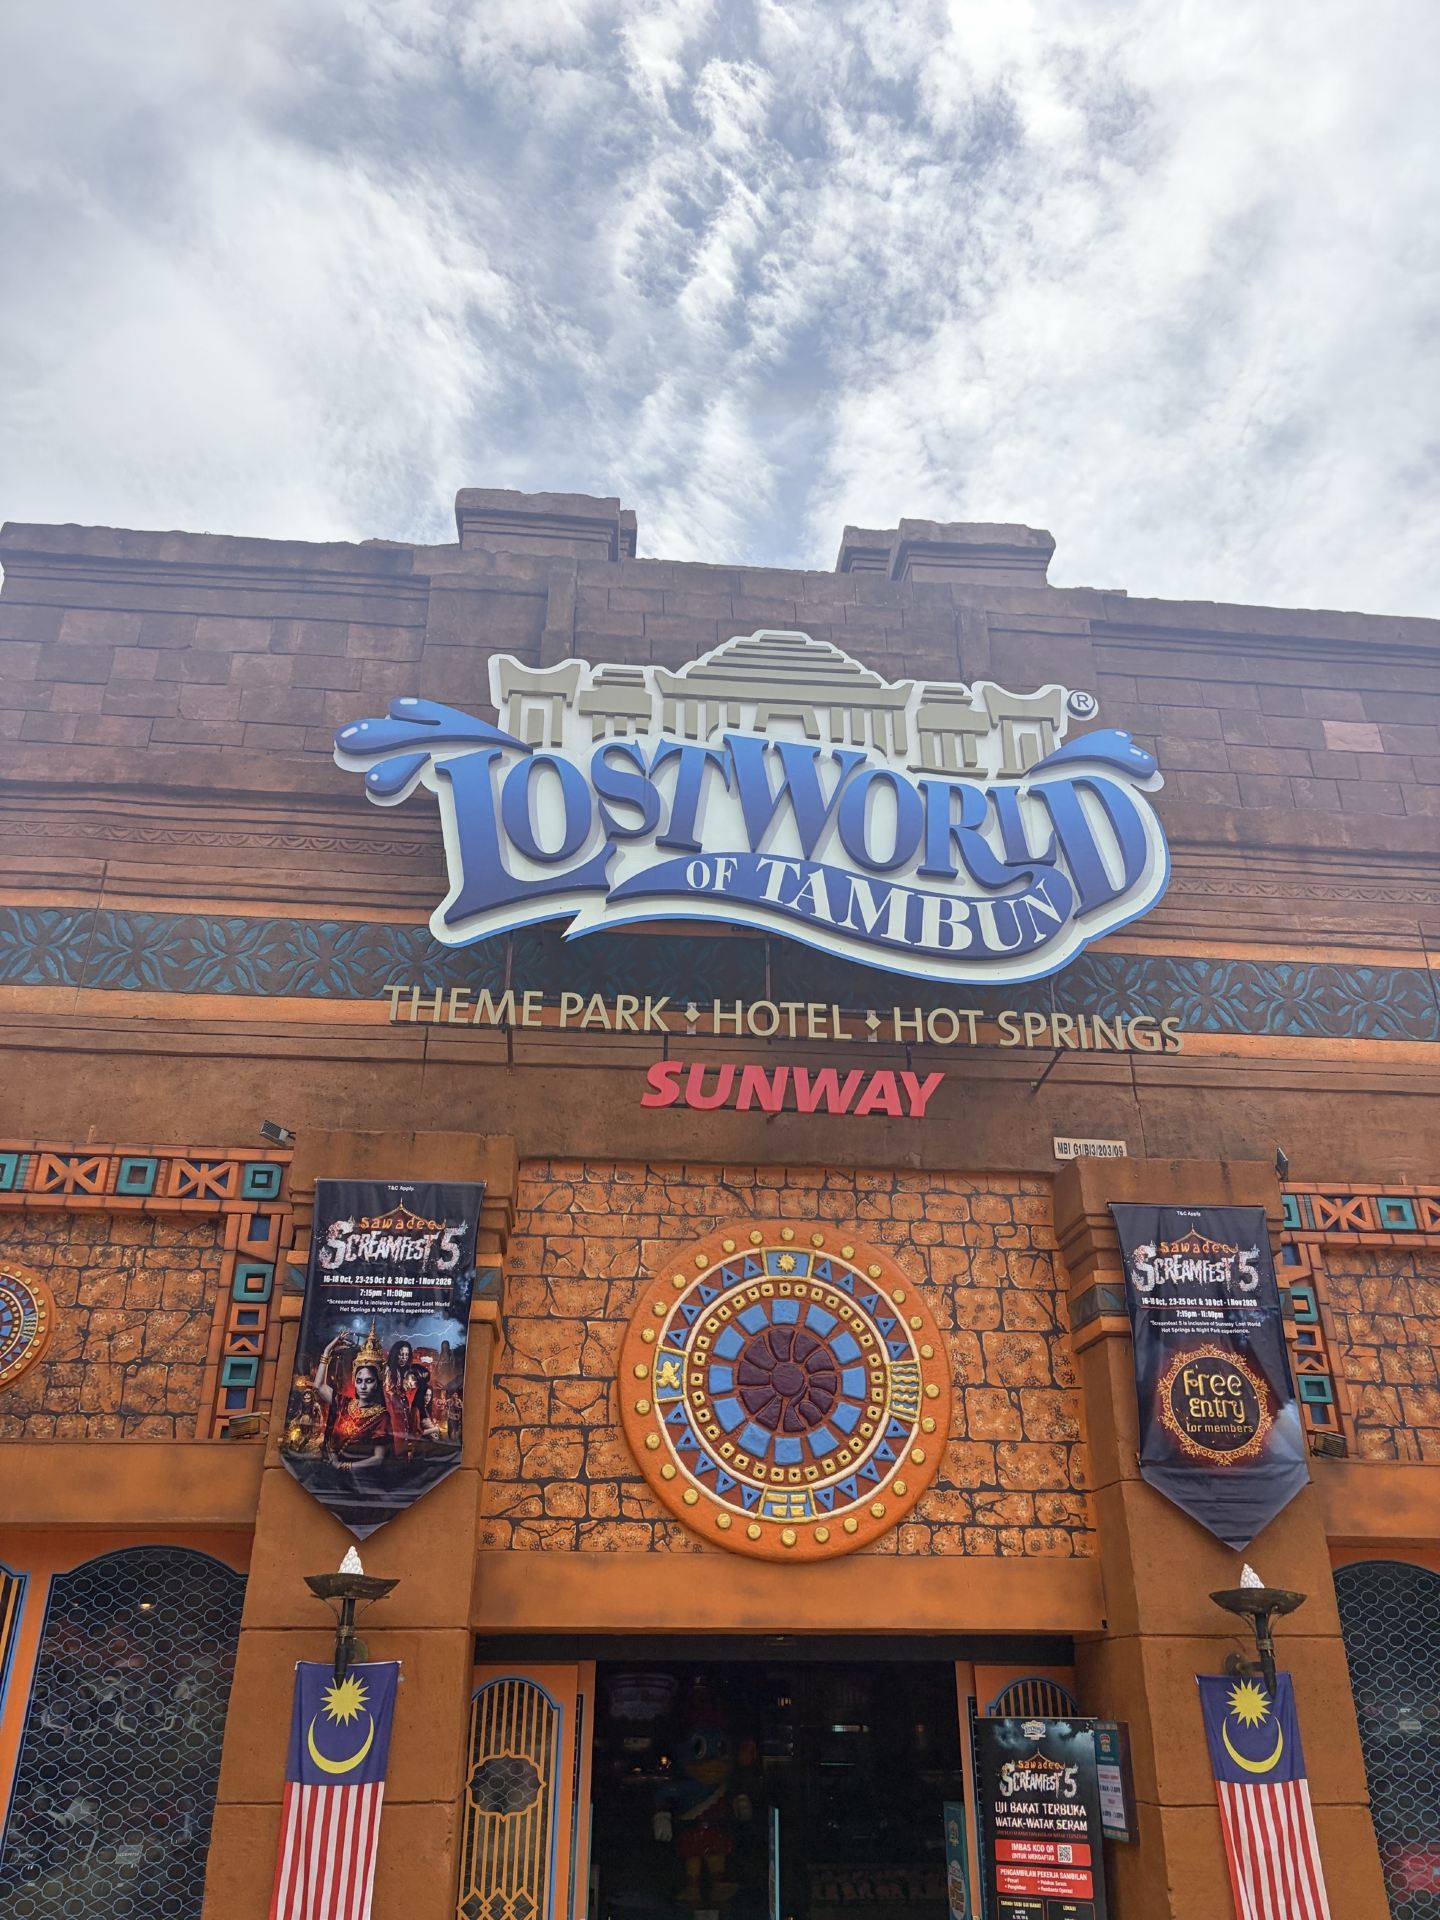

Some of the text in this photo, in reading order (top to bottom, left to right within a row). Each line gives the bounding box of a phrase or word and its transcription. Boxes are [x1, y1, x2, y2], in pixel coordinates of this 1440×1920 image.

[434, 734, 1147, 924] LOST WORLD
[685, 857, 1063, 952] OF TAMBUN
[383, 985, 1184, 1053] THEME PARK HOTEL HOT SPRINGS
[640, 1060, 945, 1118] SUNWAY
[437, 1220, 467, 1270] 5
[387, 1276, 393, 1285] &
[1238, 1243, 1260, 1292] 5
[359, 1289, 382, 1299] 7:15pm
[386, 1289, 413, 1299] 11:00pm
[1183, 1369, 1242, 1396] Free
[1204, 1423, 1254, 1433] members
[1064, 1763, 1079, 1798] 5
[995, 1801, 1087, 1816] UJI BAKAT TERBUKA
[995, 1816, 1088, 1831] WATAK-WATAK SERAM
[1011, 1843, 1031, 1851] IMBAS
[1032, 1844, 1045, 1852] KOD
[1037, 1870, 1059, 1879] PEKERJA
